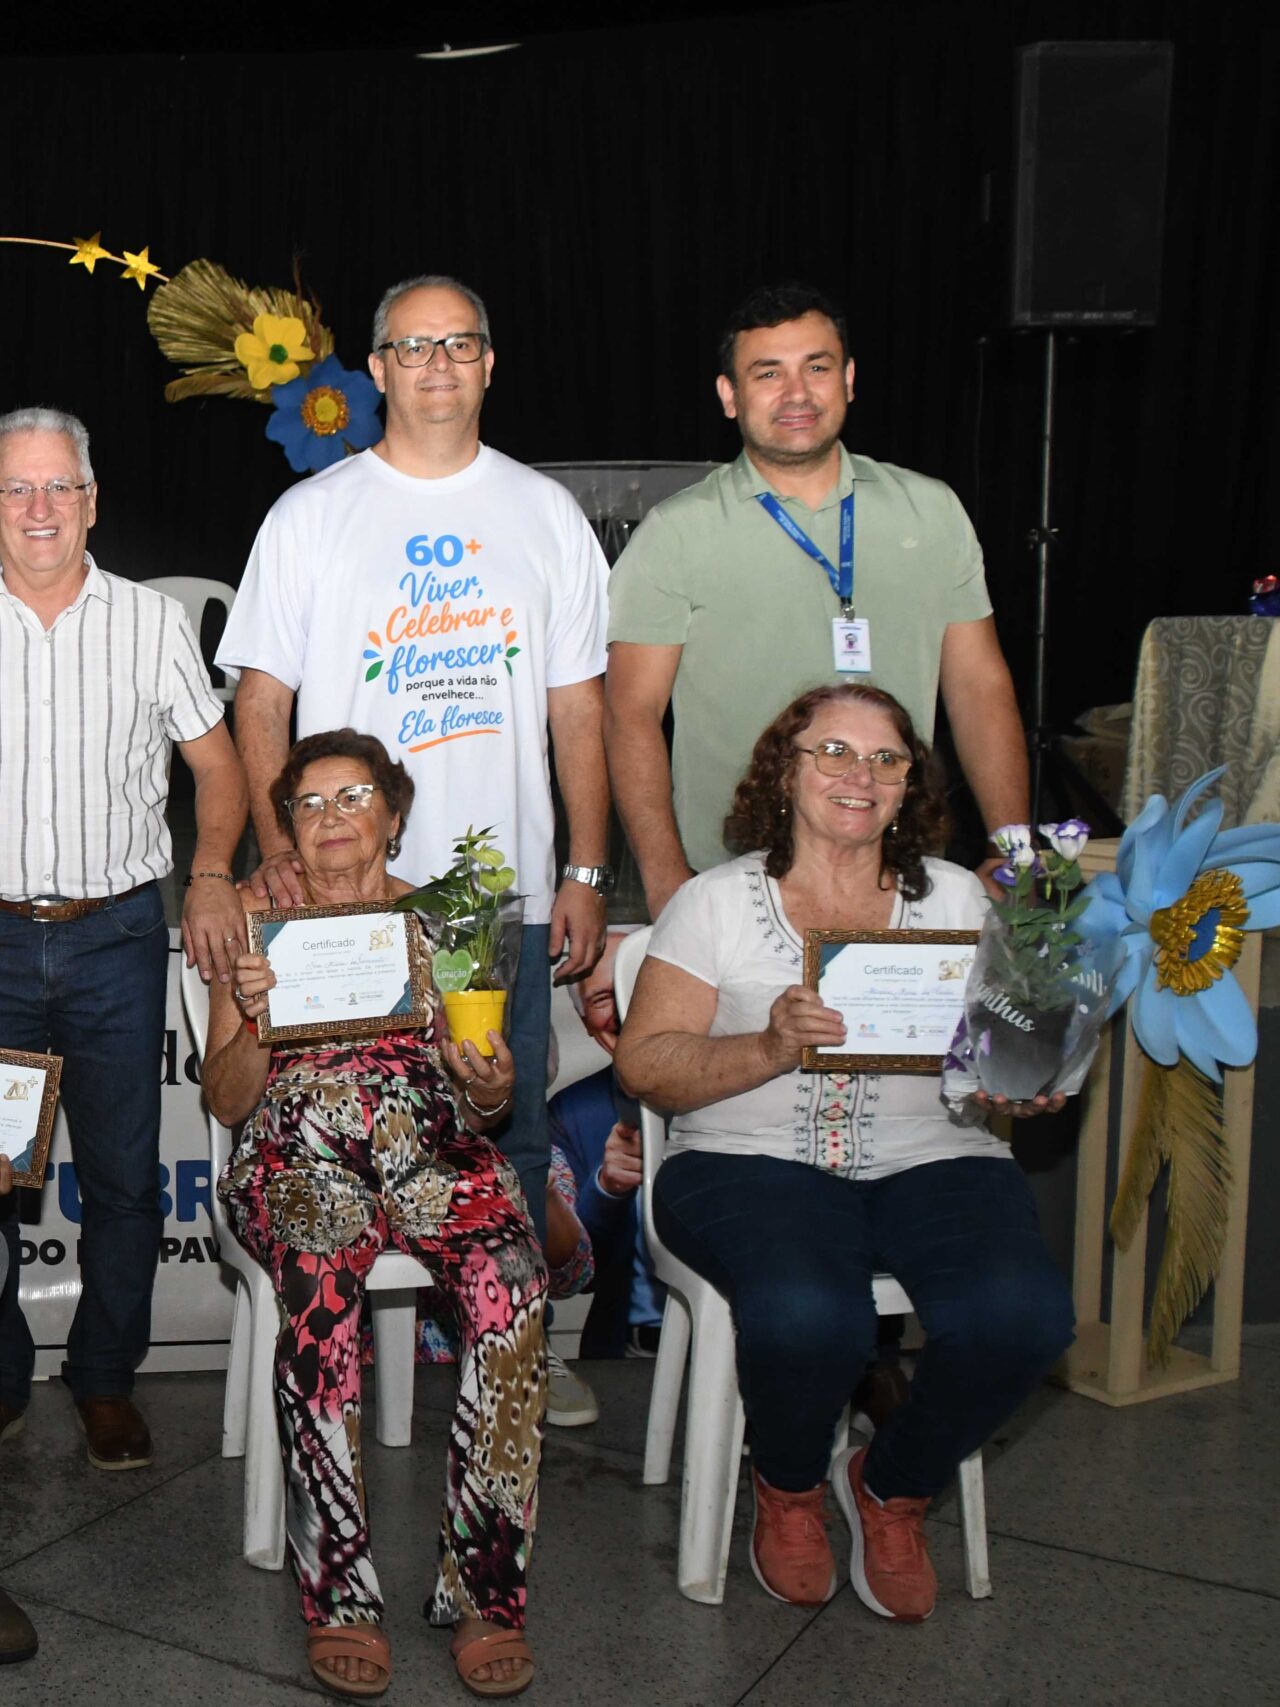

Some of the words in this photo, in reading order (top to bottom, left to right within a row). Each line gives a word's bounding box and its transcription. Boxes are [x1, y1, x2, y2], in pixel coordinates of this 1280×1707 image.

[405, 533, 483, 568] 60+
[399, 571, 483, 608] Viver,
[386, 601, 496, 645] Celebrar
[500, 607, 513, 627] e
[385, 642, 504, 695] florescer
[406, 677, 445, 692] porque
[447, 679, 455, 687] a
[456, 674, 478, 687] vida
[480, 674, 498, 687] não
[421, 688, 484, 702] envelhece...
[398, 709, 438, 745] Ela
[440, 705, 505, 737] floresce
[302, 938, 356, 951] Certificado
[863, 964, 923, 976] Certificado
